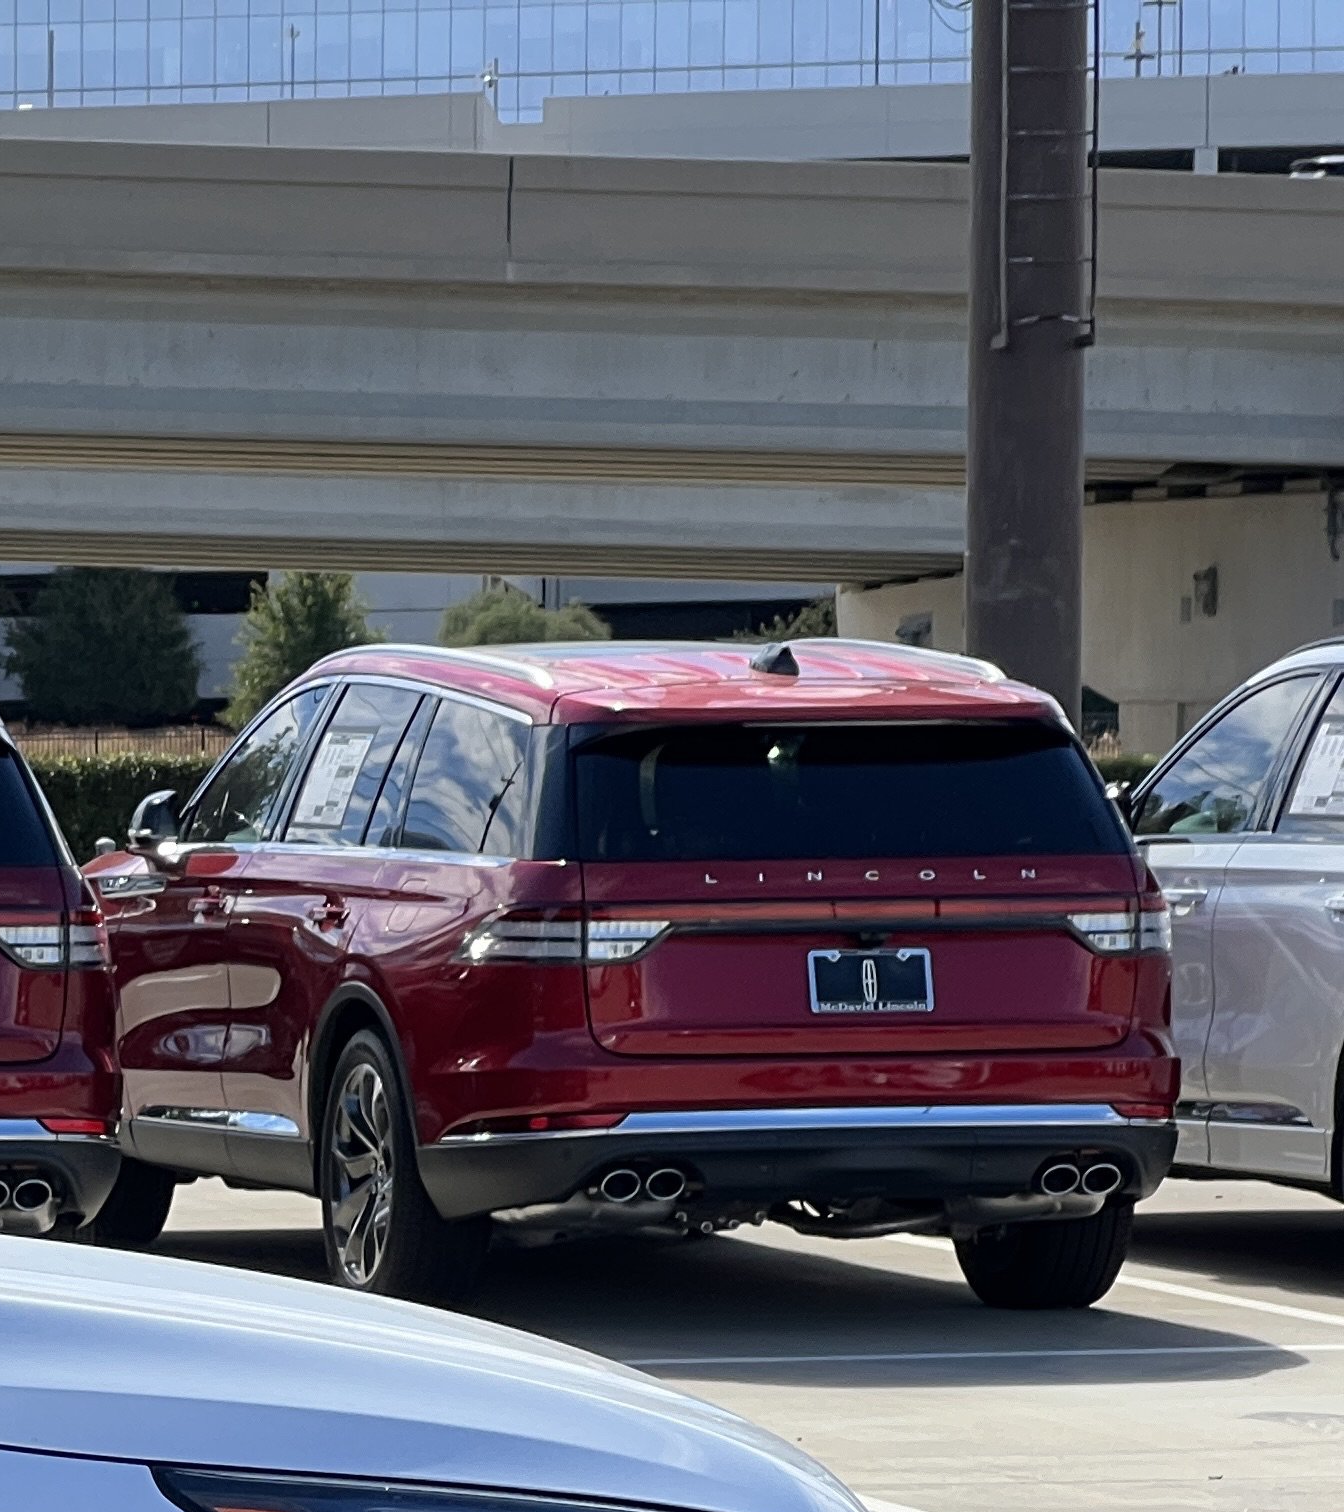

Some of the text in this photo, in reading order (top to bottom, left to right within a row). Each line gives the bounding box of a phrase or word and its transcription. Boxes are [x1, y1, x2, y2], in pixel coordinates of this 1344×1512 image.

[705, 868, 1036, 884] LINCOLN
[820, 1001, 926, 1011] McDavid Lincoln
